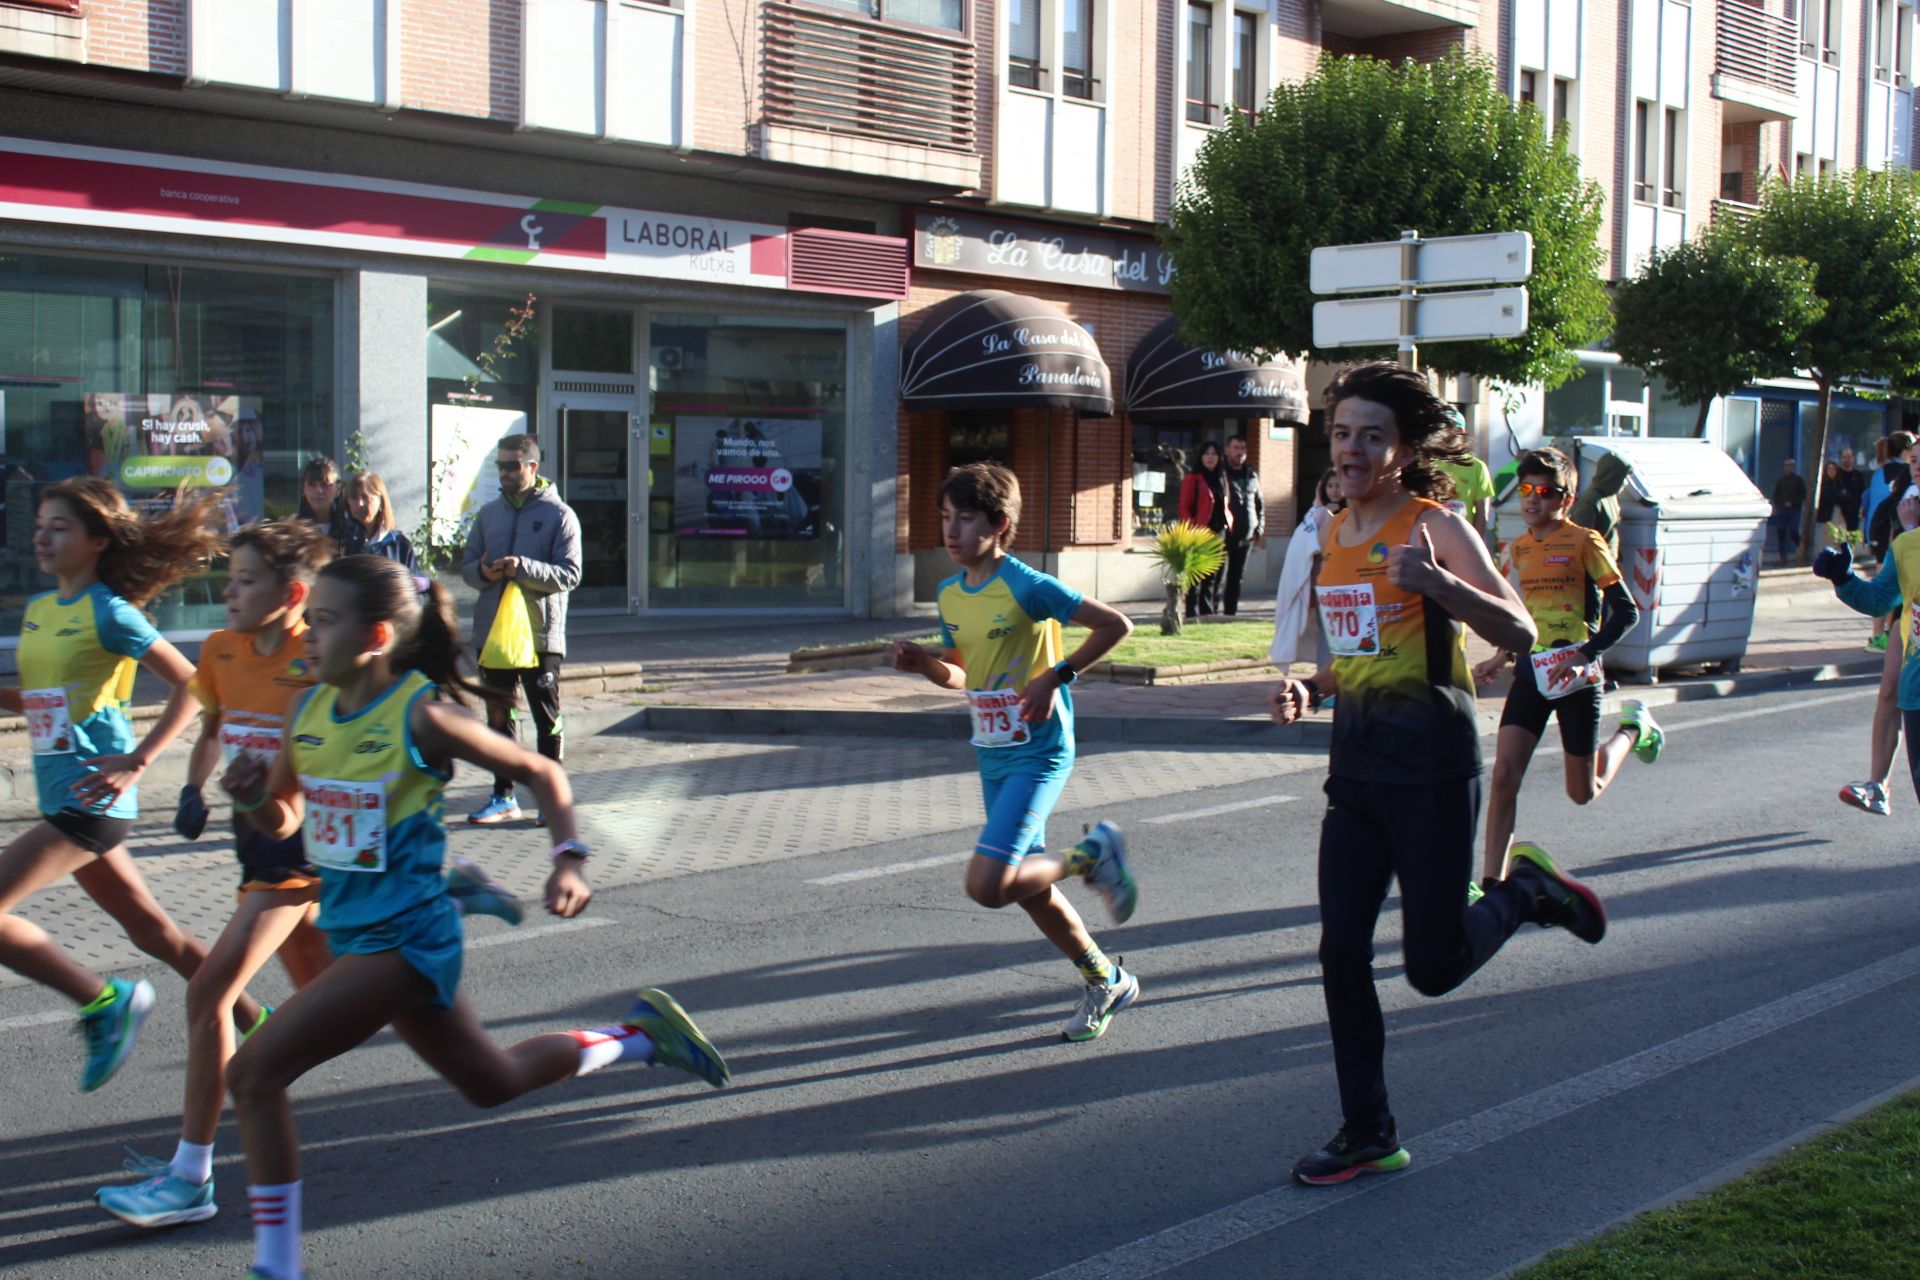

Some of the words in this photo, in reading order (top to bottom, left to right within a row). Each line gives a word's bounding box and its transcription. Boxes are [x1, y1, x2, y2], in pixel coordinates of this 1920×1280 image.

[160, 188, 188, 200] banca
[188, 191, 240, 205] cooperativa
[623, 219, 734, 253] LABORAL
[689, 253, 735, 273] Kutxa
[987, 229, 1028, 268] La
[1038, 237, 1107, 277] Casa
[1114, 248, 1149, 282] del
[982, 333, 1012, 355] La
[1013, 328, 1059, 346] Casa
[1201, 350, 1227, 371] La
[156, 418, 176, 433] hay
[178, 419, 211, 432] crush,
[151, 431, 171, 445] hay
[173, 432, 203, 444] cash.
[723, 437, 757, 447] Mundo,
[758, 438, 775, 448] nos
[717, 447, 747, 457] vamos
[749, 447, 761, 457] de
[708, 474, 726, 484] ME
[726, 474, 768, 485] PIROOO
